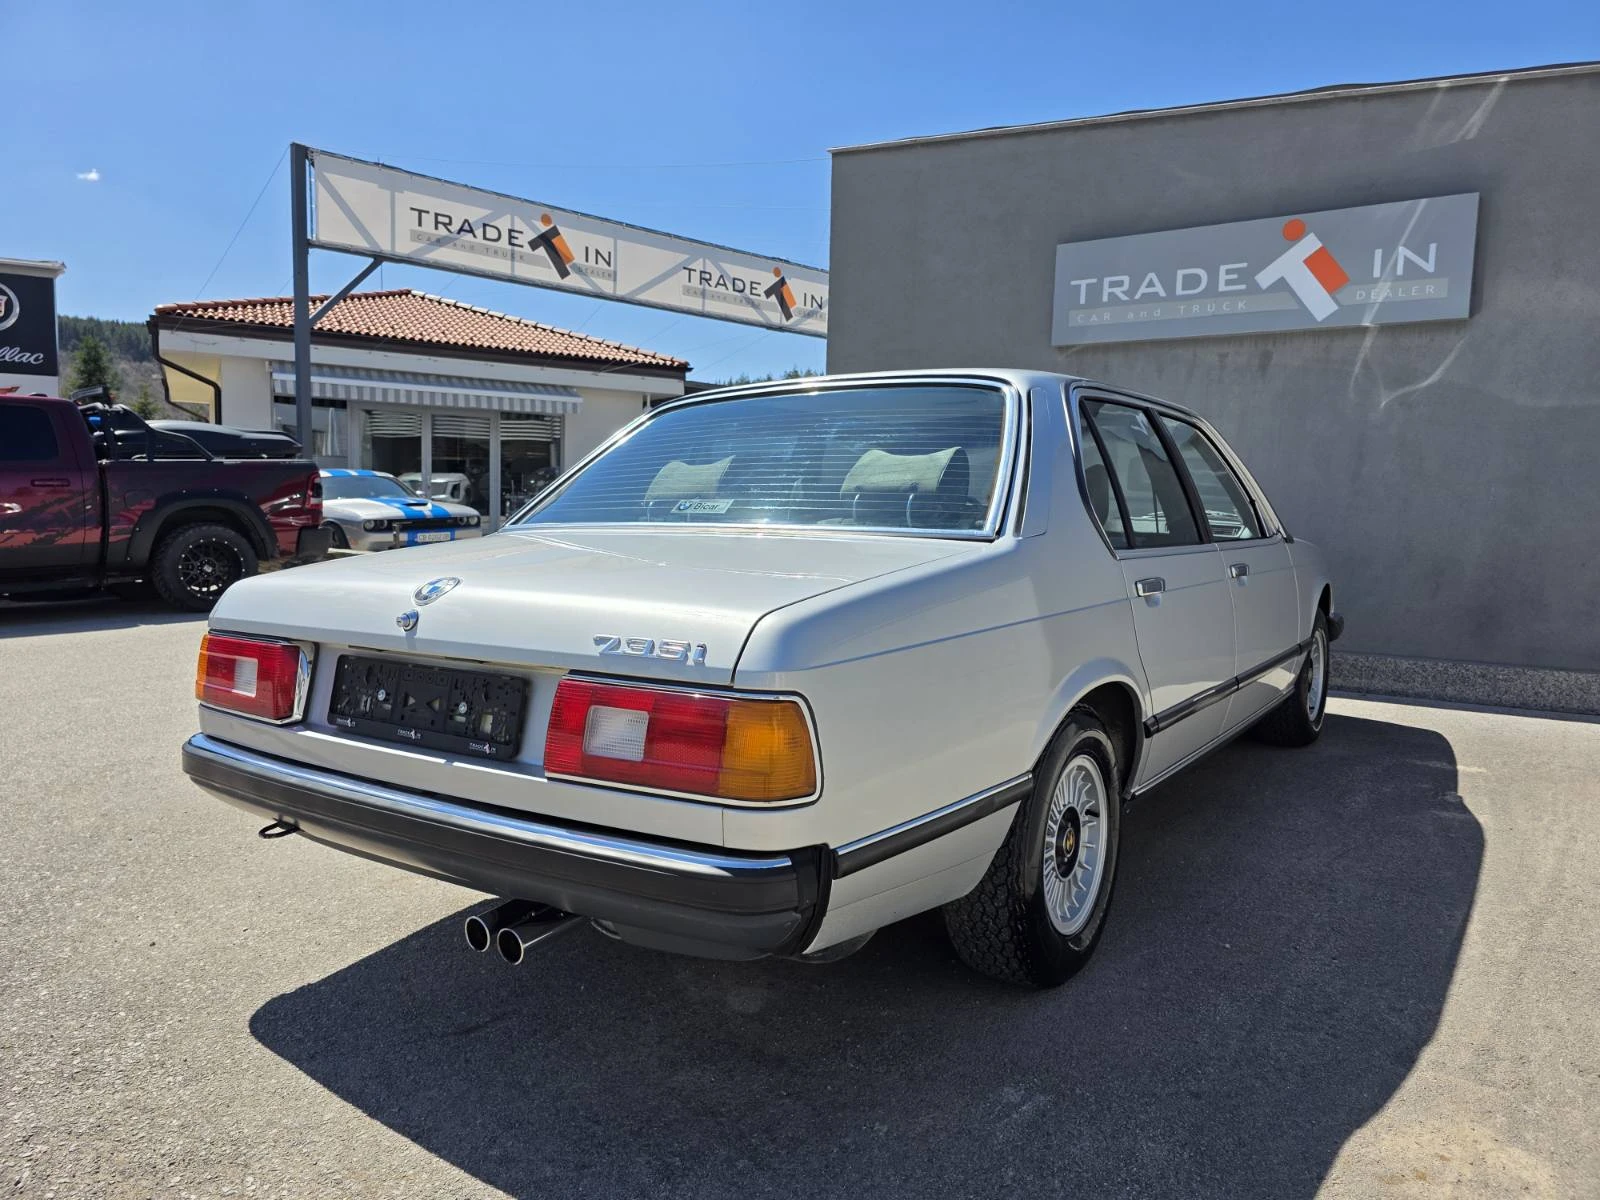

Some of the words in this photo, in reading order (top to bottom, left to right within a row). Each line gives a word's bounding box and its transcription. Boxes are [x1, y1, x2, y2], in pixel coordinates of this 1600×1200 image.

[410, 207, 525, 248] TRADE
[584, 246, 612, 268] IN
[682, 266, 762, 297] TRADE
[803, 292, 823, 310] IN
[1070, 262, 1249, 304] TRADE
[1373, 243, 1438, 278] IN
[1076, 307, 1112, 324] CAR
[1127, 308, 1161, 321] and
[1178, 300, 1248, 315] TRUCK
[1356, 285, 1436, 300] DEALER
[593, 634, 708, 664] 735i
